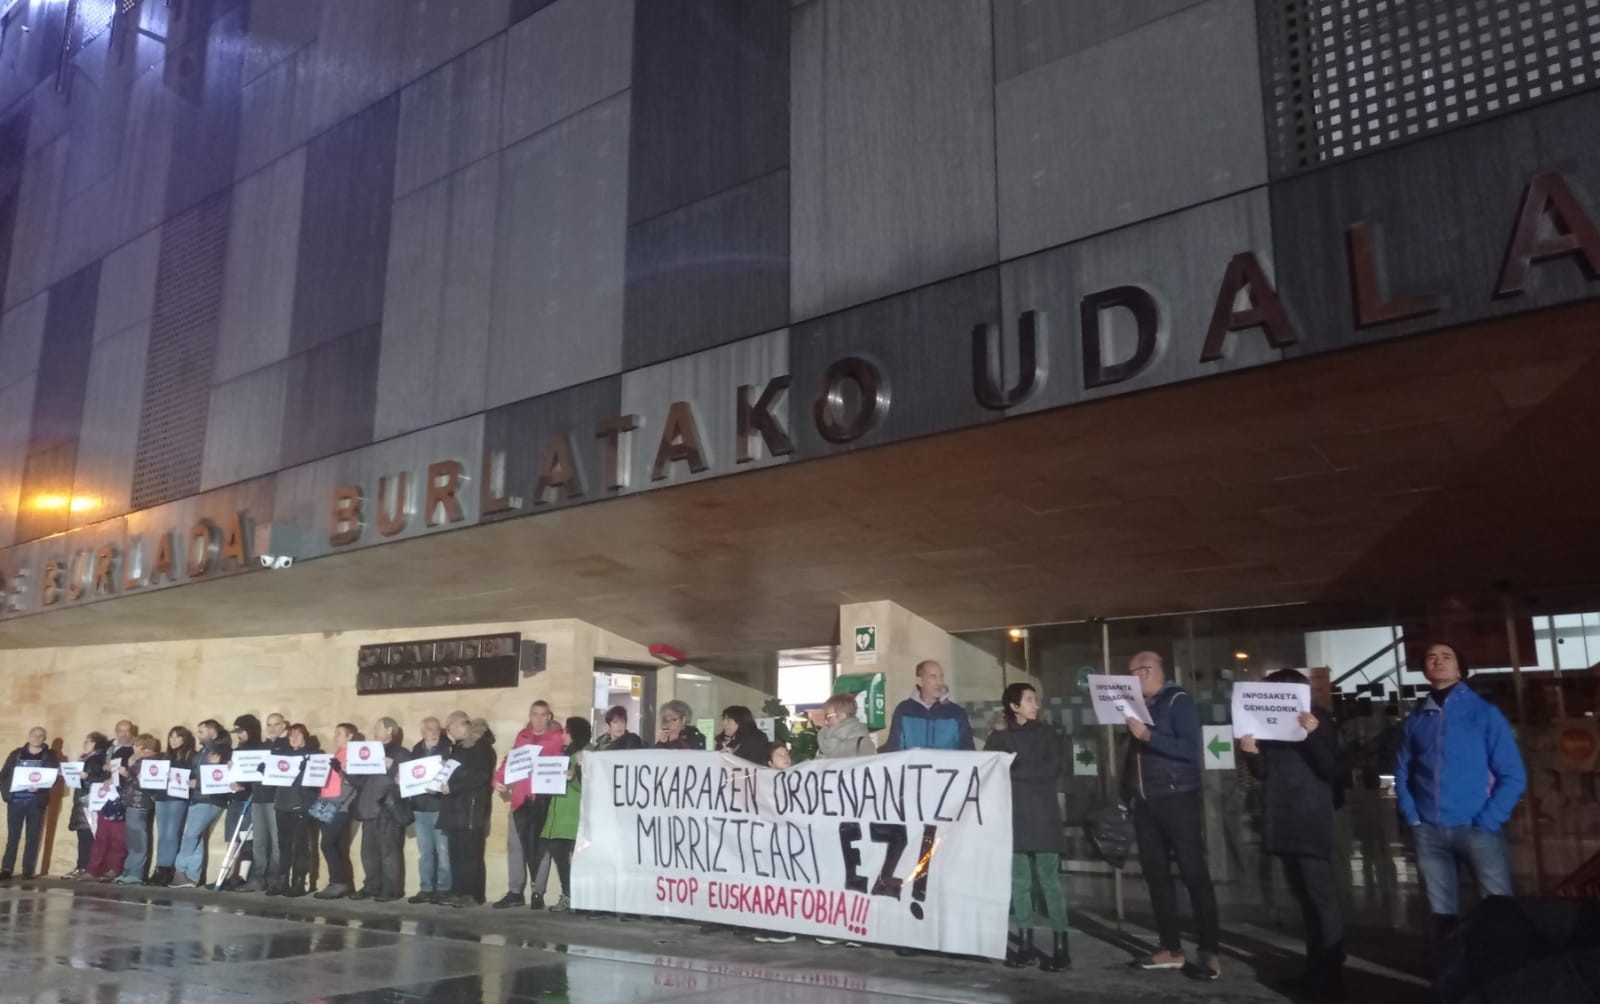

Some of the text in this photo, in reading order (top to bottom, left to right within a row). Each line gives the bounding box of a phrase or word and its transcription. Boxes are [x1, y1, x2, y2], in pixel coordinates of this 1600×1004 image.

[330, 170, 1600, 548] BURLATAKO UDALA
[1242, 692, 1298, 700] INPOSAKETA
[613, 764, 983, 826] EUSKARAREN ORDENANTZA
[637, 814, 942, 921] MURRIZTEARI EZ!
[656, 876, 871, 936] STOP EUSKARAFOBIA!!!
